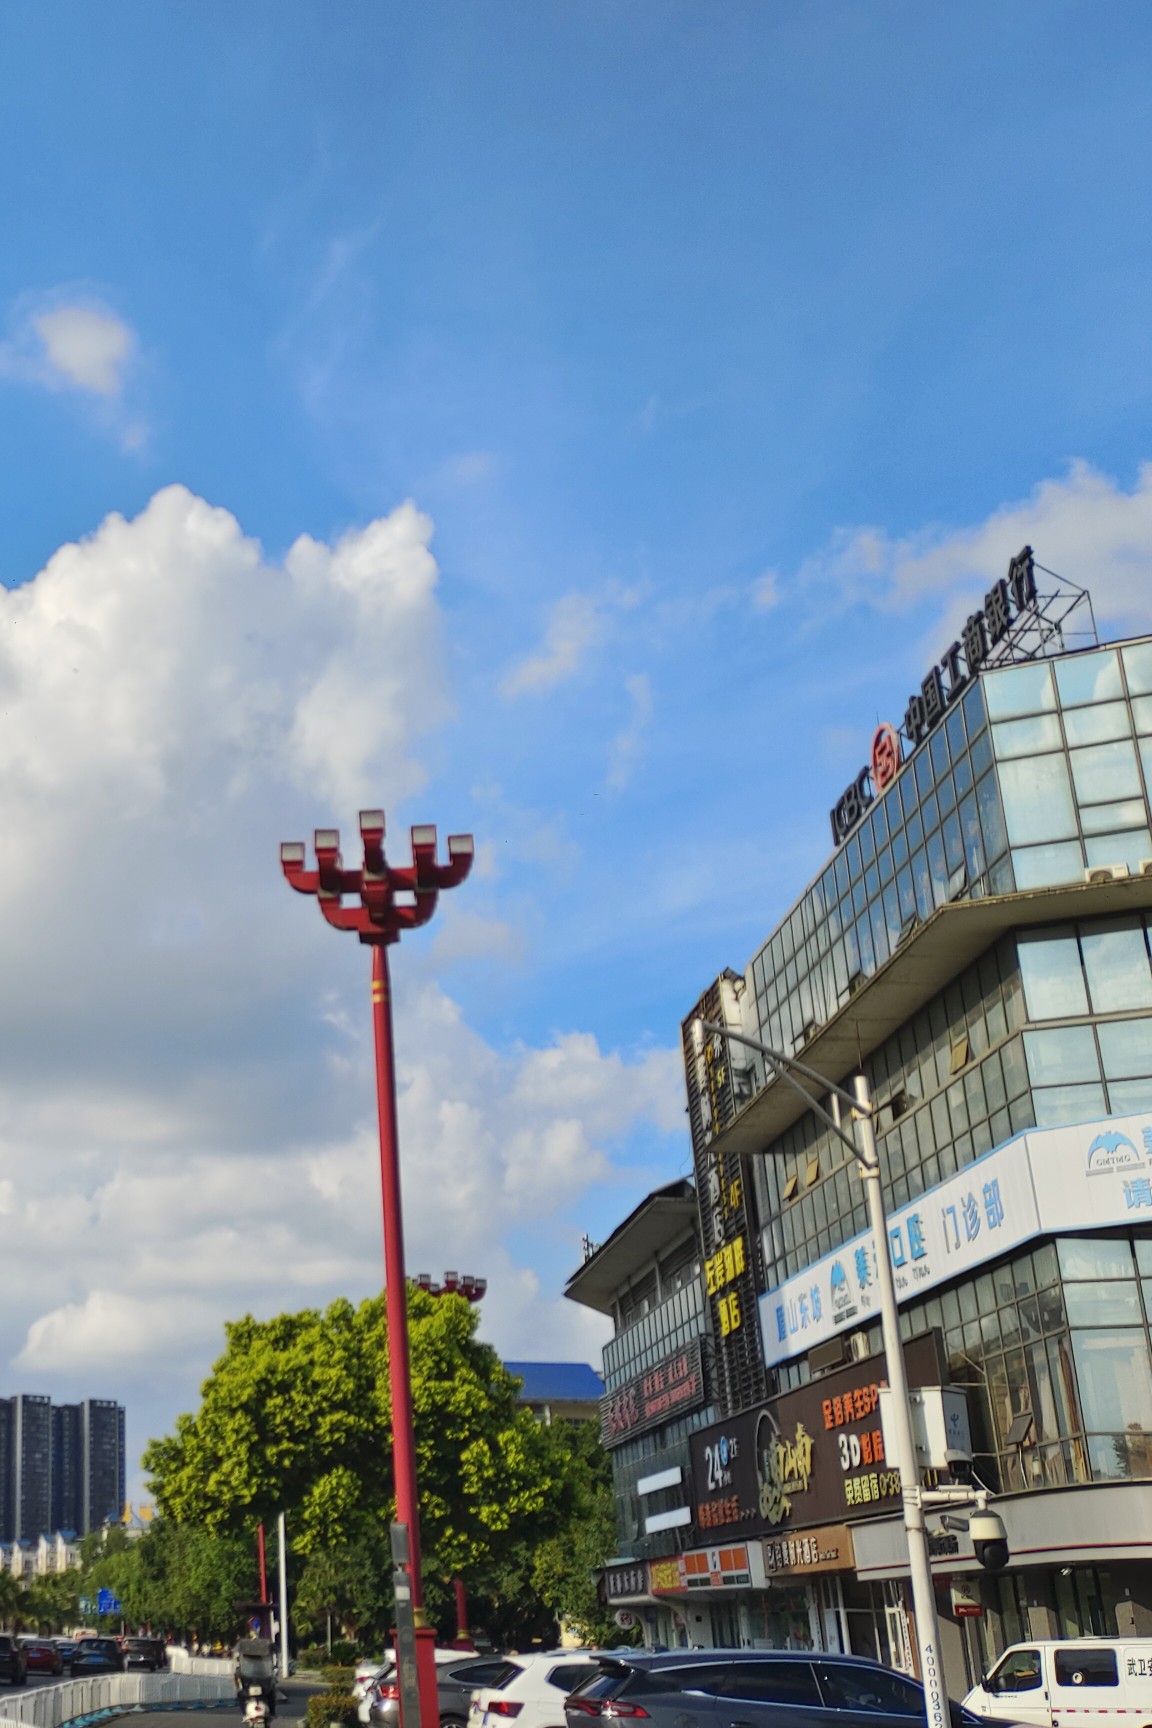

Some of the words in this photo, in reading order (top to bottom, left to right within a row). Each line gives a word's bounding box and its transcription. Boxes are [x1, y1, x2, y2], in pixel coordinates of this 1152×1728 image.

[905, 545, 1038, 744] 中国工商银行
[830, 765, 874, 847] ICBC
[942, 1178, 1005, 1254] 门诊部
